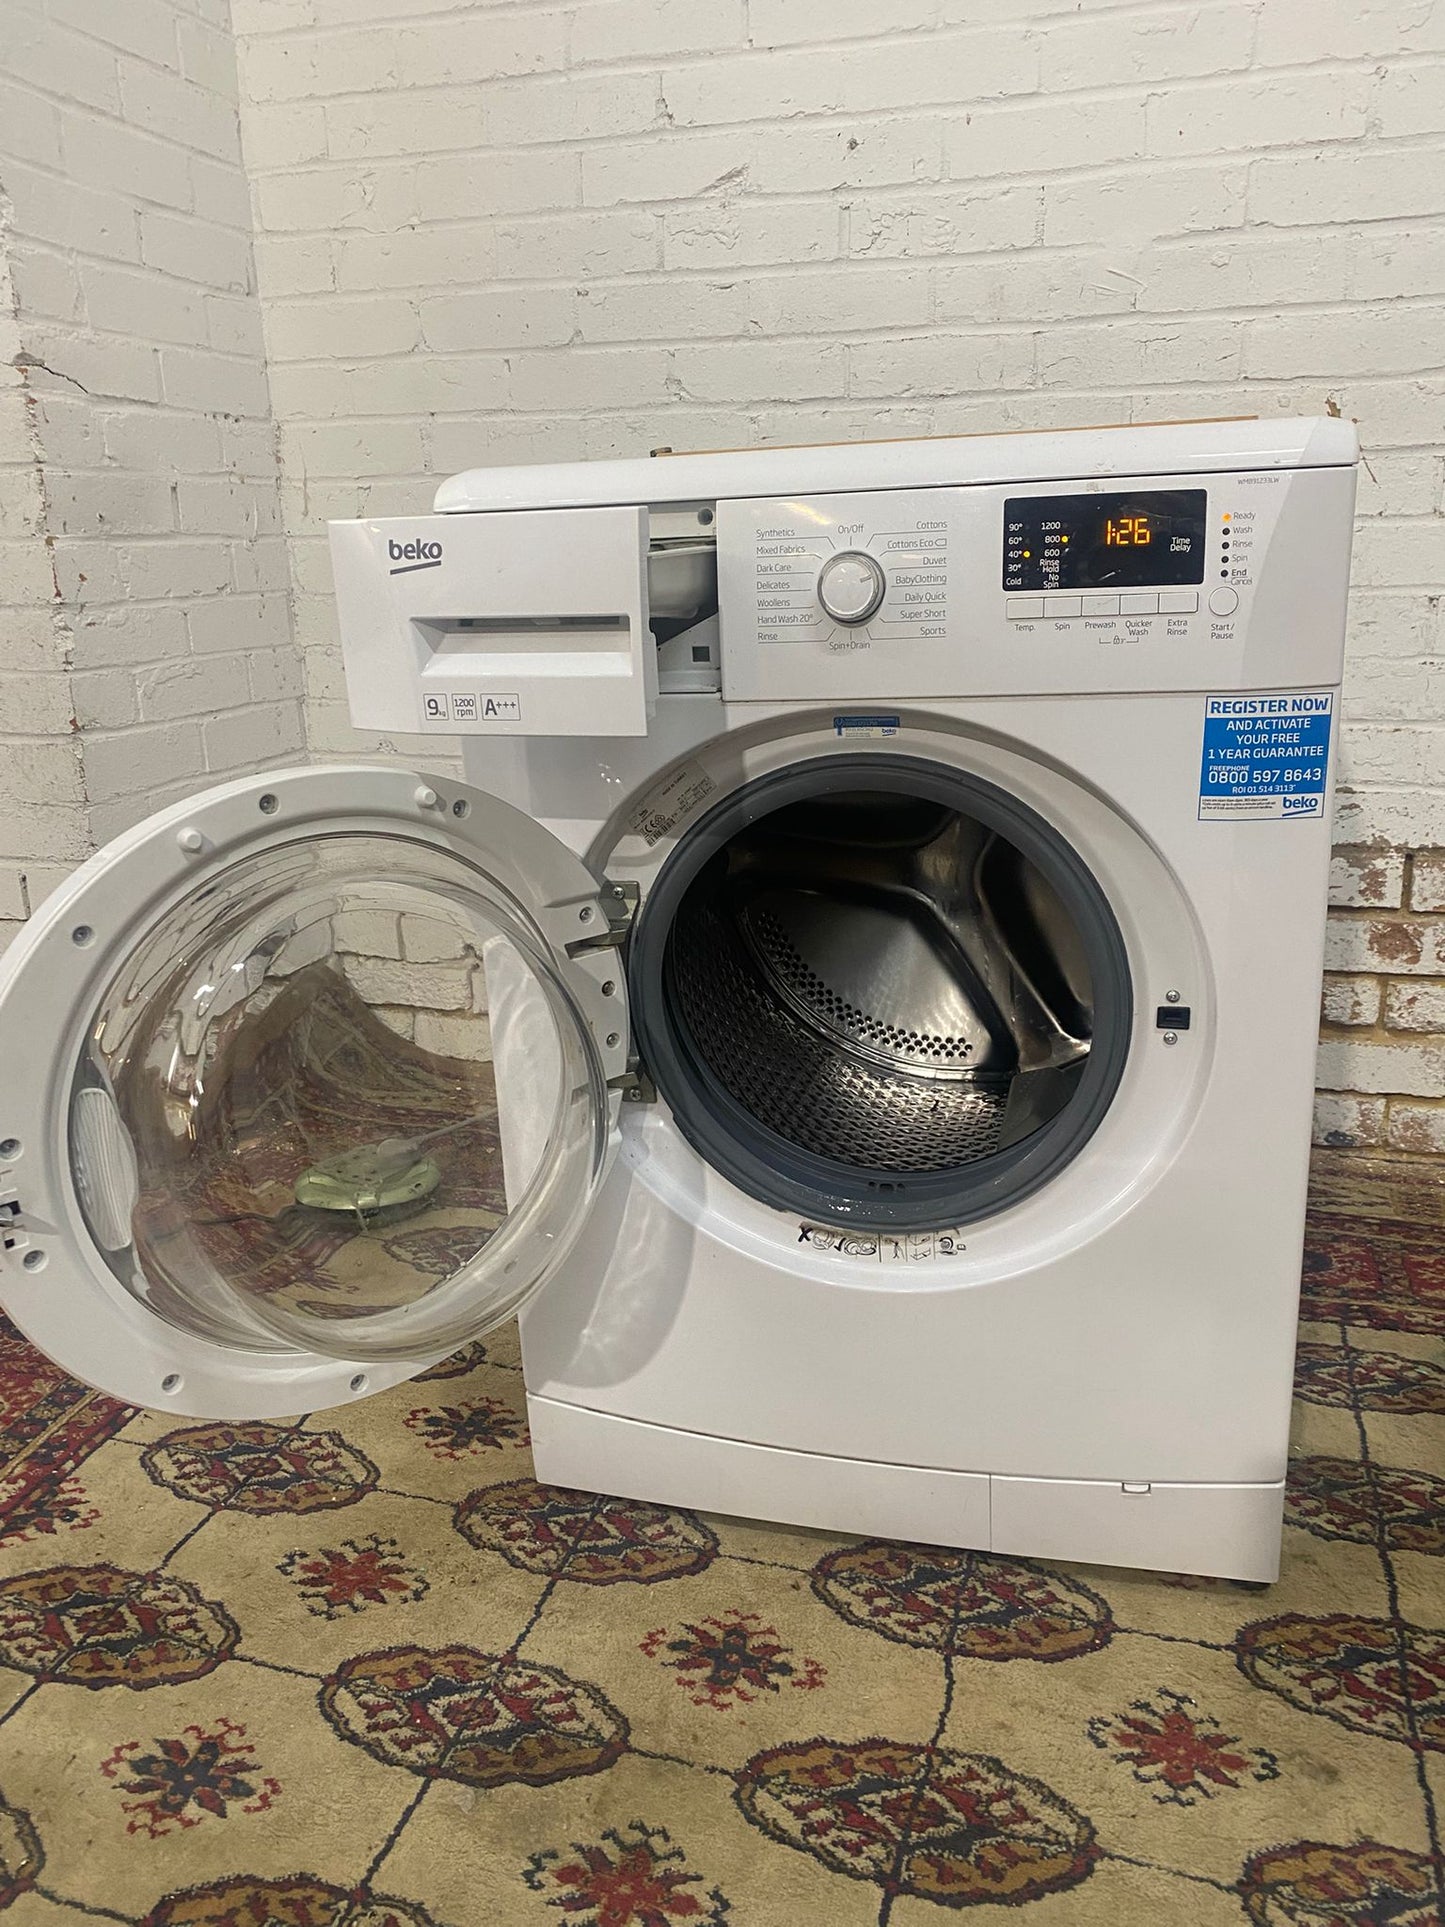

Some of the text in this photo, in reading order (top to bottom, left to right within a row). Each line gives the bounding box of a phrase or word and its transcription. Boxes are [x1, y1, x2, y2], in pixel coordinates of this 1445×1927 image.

[1233, 511, 1256, 521] Ready
[838, 524, 865, 534] On/Off
[916, 520, 948, 529] Cottons
[1041, 521, 1061, 530] 1200
[756, 529, 795, 538] Synthetics
[1106, 518, 1151, 545] 1:26
[1233, 526, 1253, 534] Wash
[887, 538, 934, 549] Cottons Eco
[1044, 535, 1061, 544] 800
[1171, 536, 1191, 545] Time
[1232, 540, 1253, 548] Rinse
[388, 538, 442, 560] beko
[756, 545, 806, 554] Mixed Fabrics
[1044, 548, 1060, 557] 600
[1169, 543, 1192, 553] Delay
[922, 556, 947, 565] Duvet
[1232, 554, 1248, 563] Spin
[757, 564, 774, 572] Dark
[1042, 565, 1060, 573] Hold
[1006, 577, 1022, 586] Cold
[1048, 573, 1060, 581] No
[1231, 577, 1253, 586] Cancel
[757, 581, 790, 590] Delicates
[1043, 580, 1059, 590] Spin
[905, 591, 947, 603] Daily Quick
[757, 598, 791, 607] Woollens
[757, 615, 777, 624] Hand
[778, 614, 799, 623] Wash
[900, 609, 946, 620] Super Short
[1015, 623, 1036, 632] Temp.
[1054, 622, 1070, 631] Spin
[1085, 621, 1117, 629] Prewash
[1125, 619, 1153, 629] Quicker
[1167, 619, 1188, 627] Extra
[920, 626, 946, 636] Sports
[1167, 628, 1187, 636] Rinse
[1211, 631, 1234, 639] Pause
[757, 632, 778, 641] Rinse
[829, 641, 870, 650] Spin+Drain
[454, 698, 474, 707] 1200
[485, 698, 516, 716] A+++
[1210, 698, 1329, 714] REGISTER NOW
[457, 709, 473, 717] rpm
[1226, 718, 1312, 731] AND ACTIVATE
[1236, 733, 1300, 745] YOUR FREE
[1208, 746, 1324, 759] 1 YEAR GUARANTEE
[1208, 768, 1321, 784] 0800 597 8643
[1232, 786, 1247, 794] ROI
[1258, 785, 1273, 793] 514
[1283, 797, 1318, 808] beko
